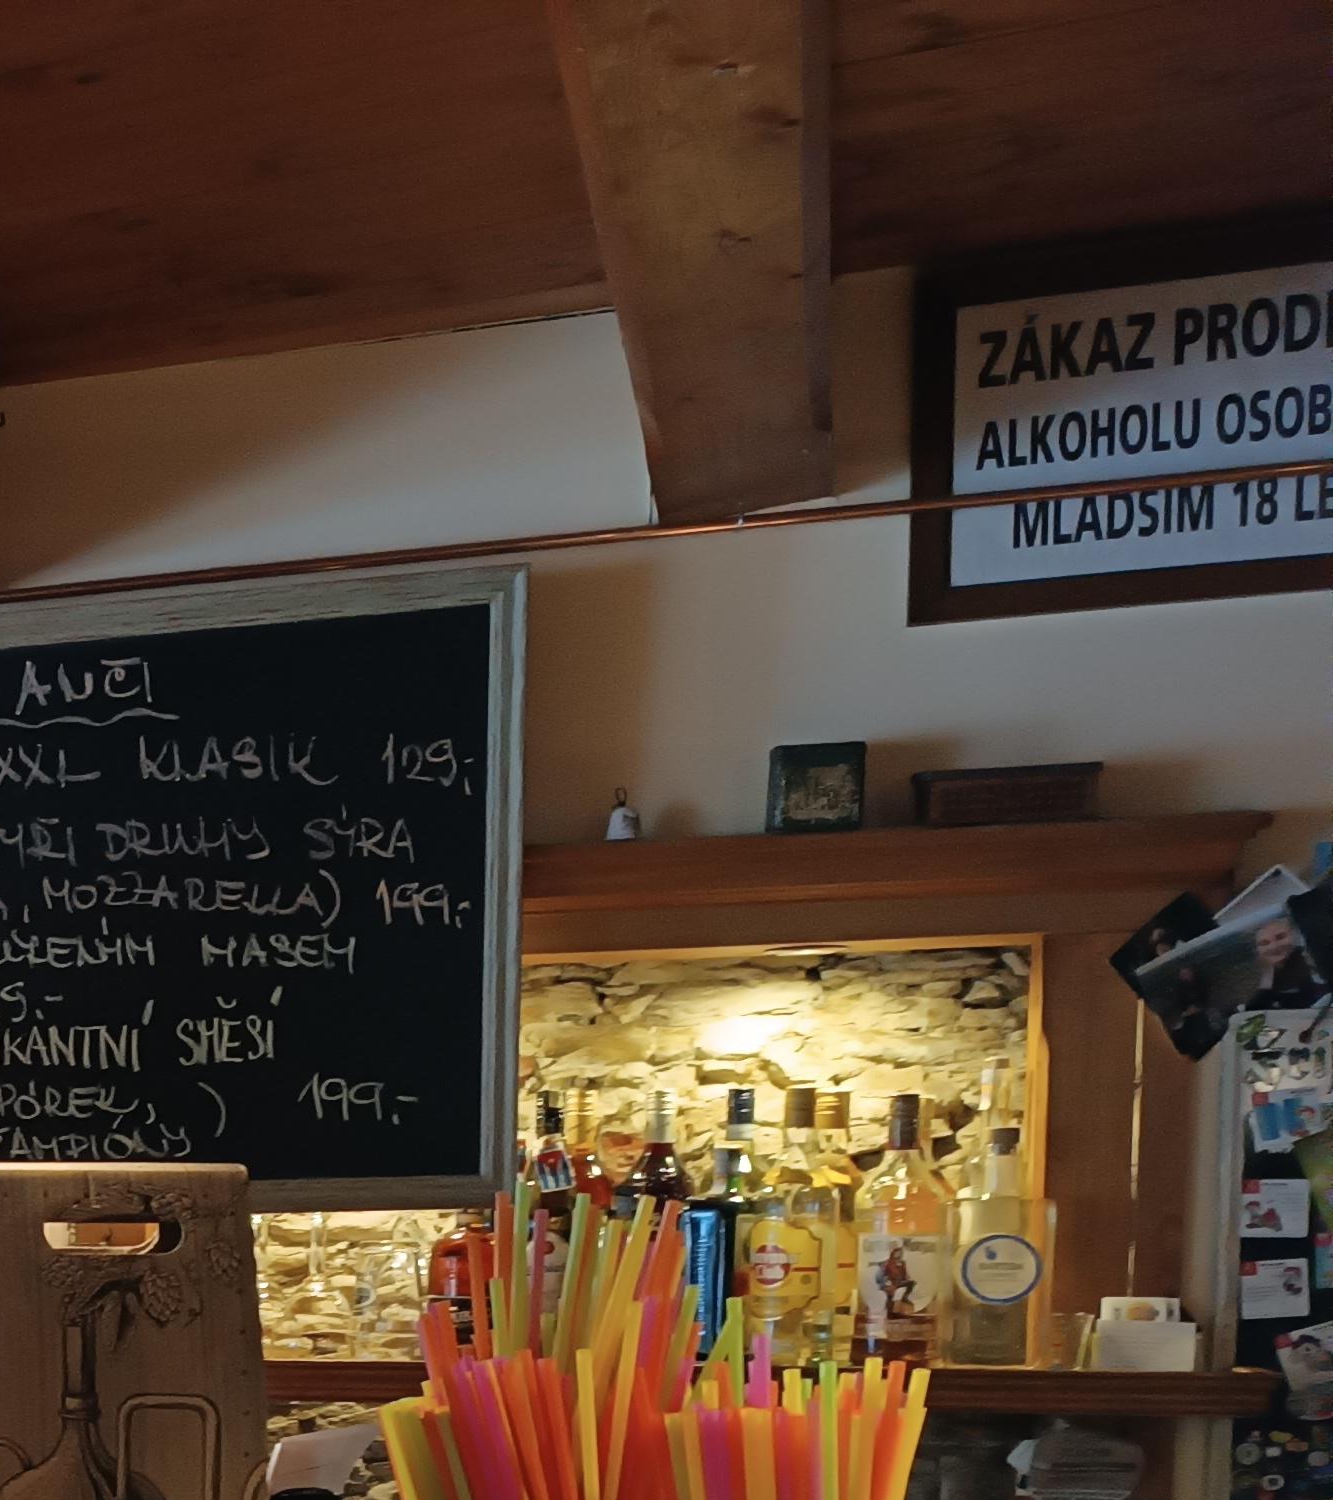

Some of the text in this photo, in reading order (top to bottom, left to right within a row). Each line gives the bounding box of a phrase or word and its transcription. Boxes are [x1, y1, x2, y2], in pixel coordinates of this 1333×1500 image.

[978, 311, 1156, 389] ZÁKAZ
[975, 397, 1201, 471] ALKOHOLU
[1234, 477, 1279, 529] 18
[139, 734, 338, 786] KLASIK
[96, 815, 271, 863] DRUHY
[302, 803, 415, 863] SÝRA
[202, 934, 358, 975] MASEM
[176, 985, 284, 1066] SMĚSÍ
